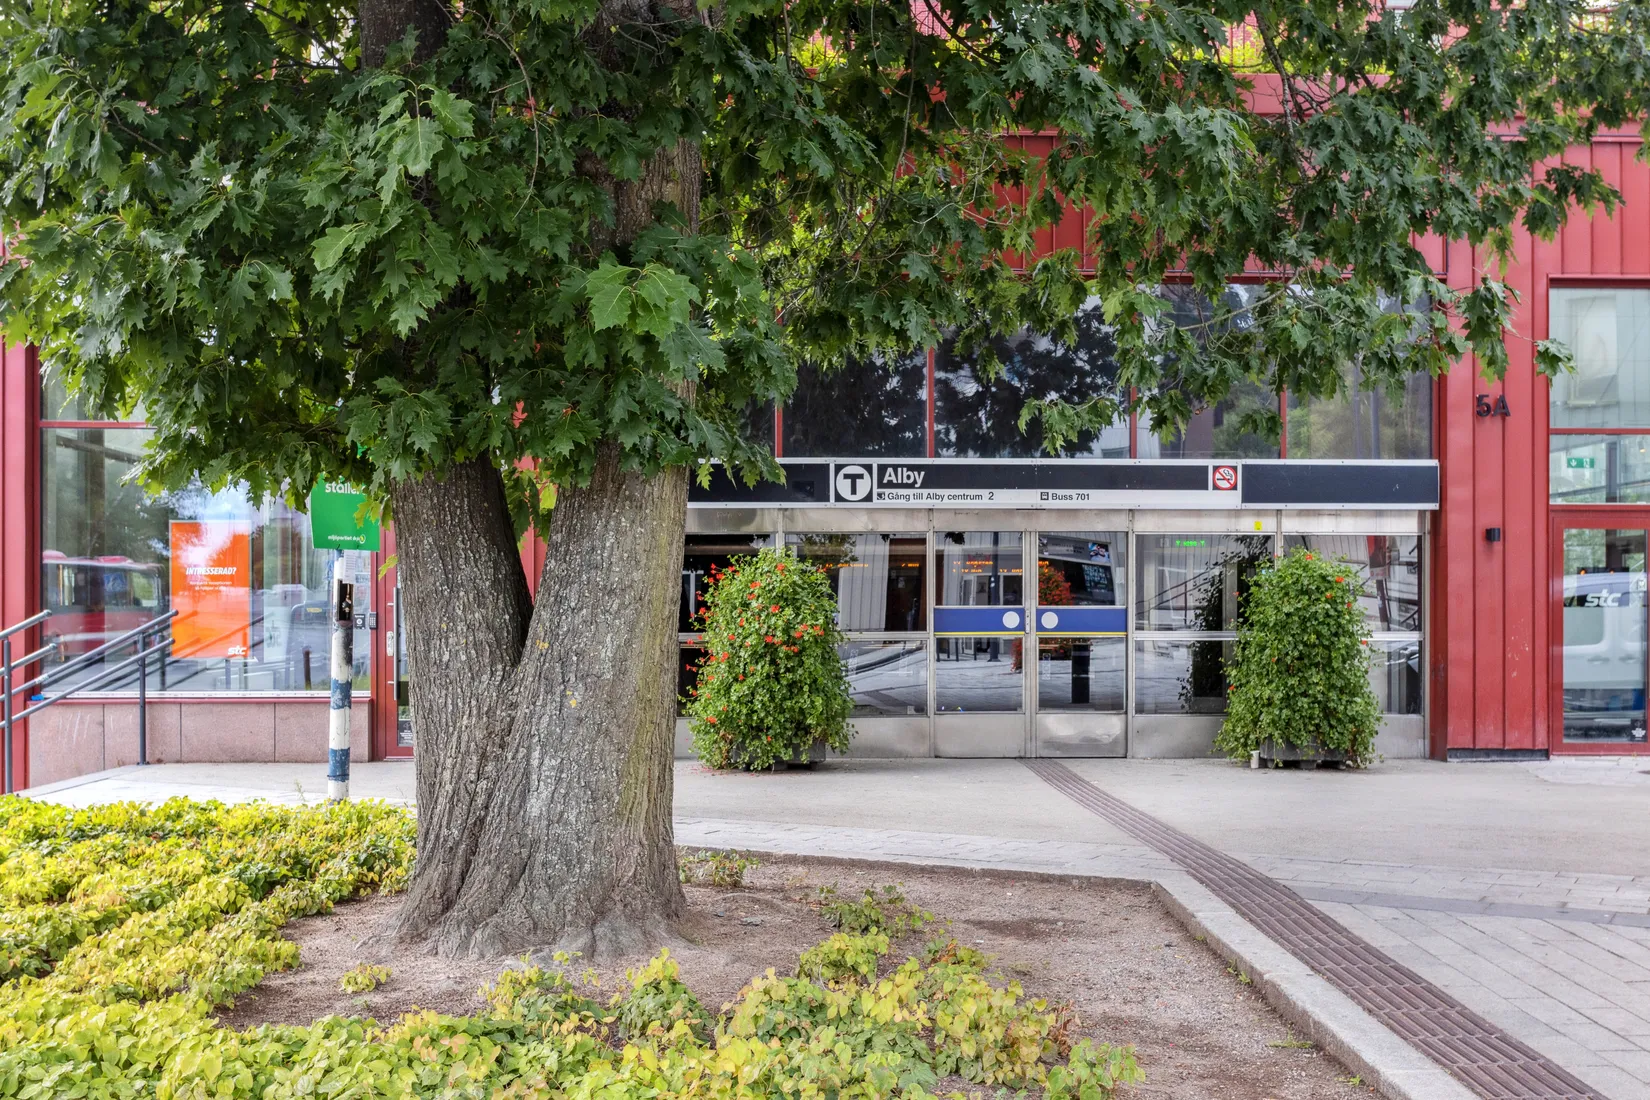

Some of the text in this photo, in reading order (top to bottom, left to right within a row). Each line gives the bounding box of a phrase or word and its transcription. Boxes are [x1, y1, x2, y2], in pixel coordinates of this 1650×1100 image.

[1476, 394, 1511, 417] 5A
[843, 473, 864, 496] T
[883, 467, 925, 488] Alby
[887, 492, 995, 502] Gång till Alby centrum 2
[1051, 493, 1090, 501] Buss 701
[186, 567, 237, 575] INTRESSERAD?
[1584, 588, 1622, 607] stc
[227, 645, 247, 655] stc
